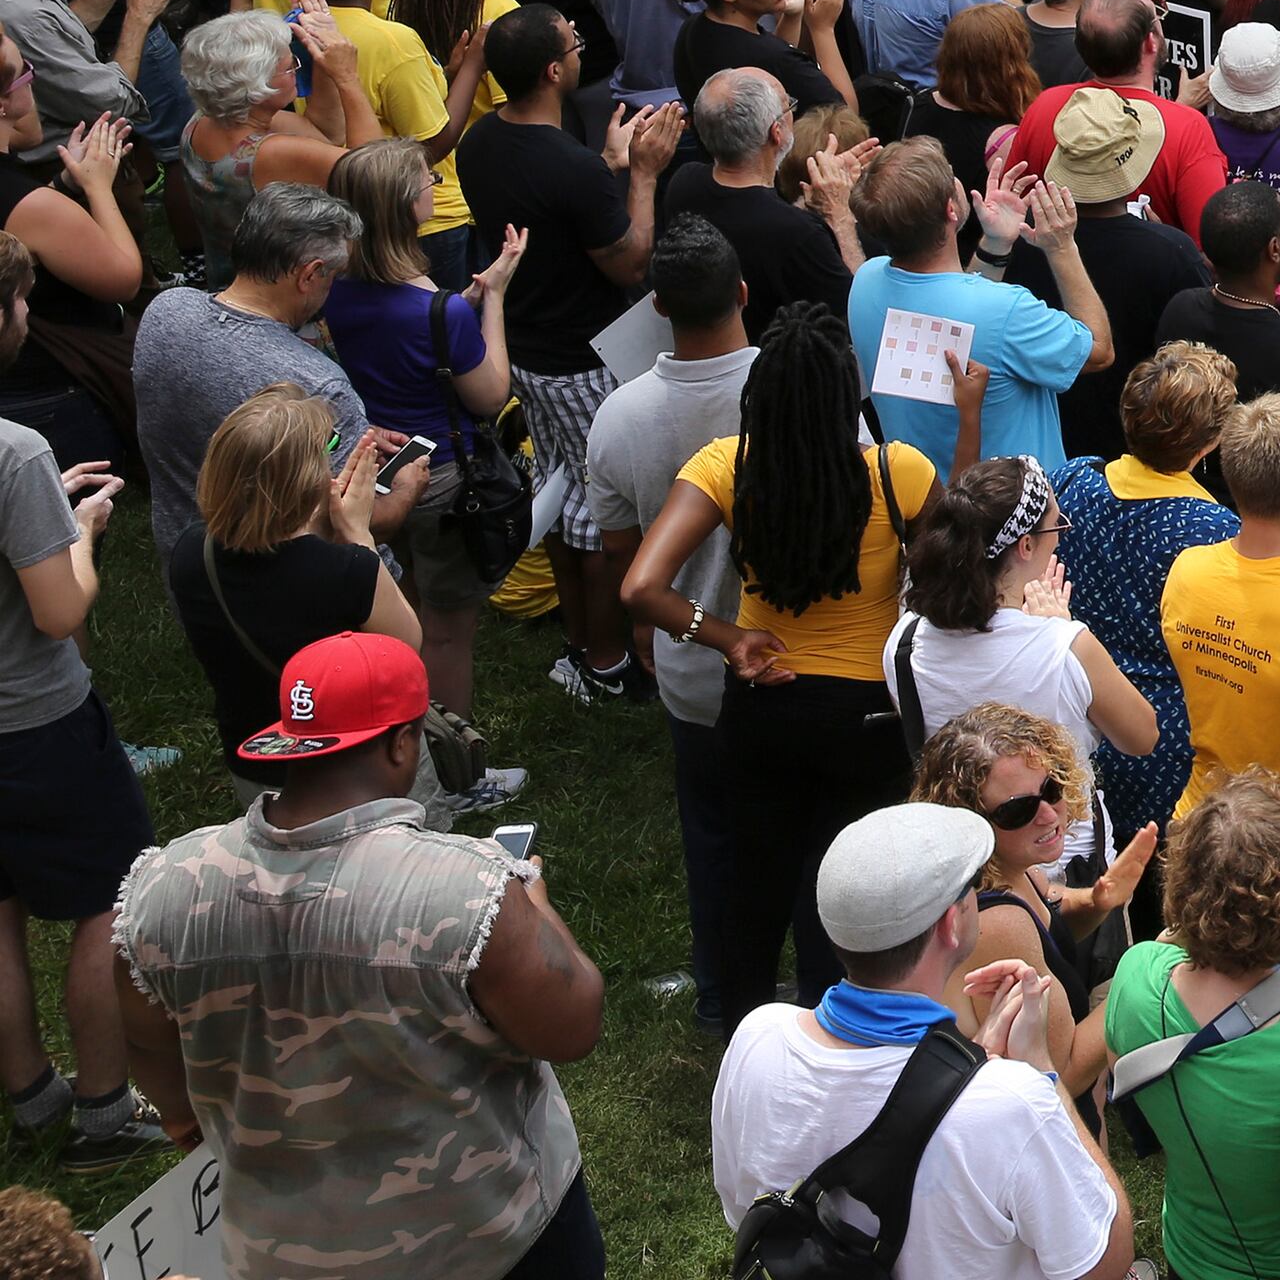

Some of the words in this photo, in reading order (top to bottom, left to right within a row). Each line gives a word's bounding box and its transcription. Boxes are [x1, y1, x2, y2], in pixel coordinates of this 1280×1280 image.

[1114, 146, 1134, 167] 1906
[1215, 615, 1236, 631] First
[1176, 620, 1232, 647] Universalist
[1233, 638, 1272, 663] Church
[1182, 640, 1193, 650] of
[1196, 642, 1258, 674] Minneapolis
[1195, 665, 1245, 695] firstuniv.org
